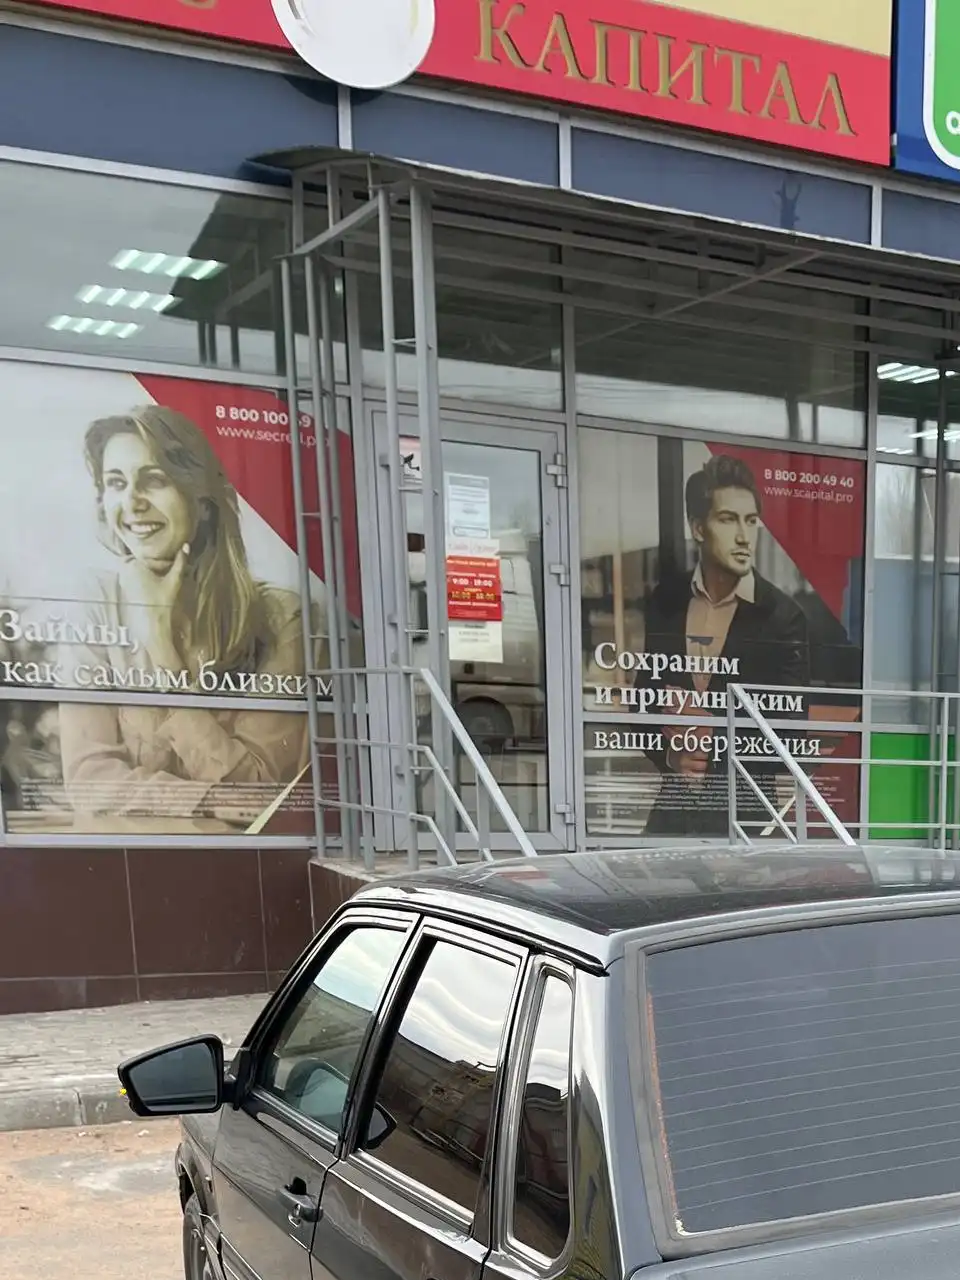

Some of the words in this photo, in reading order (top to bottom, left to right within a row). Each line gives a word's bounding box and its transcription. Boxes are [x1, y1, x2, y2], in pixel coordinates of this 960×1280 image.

[475, 0, 857, 136] КАПИТАЛ
[215, 405, 226, 418] 8
[229, 406, 259, 422] 800
[262, 410, 289, 425] 100
[764, 468, 772, 480] 8
[775, 469, 797, 482] 800
[799, 472, 820, 484] 200
[822, 475, 837, 486] 49
[839, 477, 854, 488] 40
[0, 608, 140, 653] Займы,
[594, 642, 740, 680] Сохраним
[2, 659, 60, 685] как
[74, 664, 189, 691] самым
[594, 685, 614, 705] и
[594, 731, 664, 751] ваши
